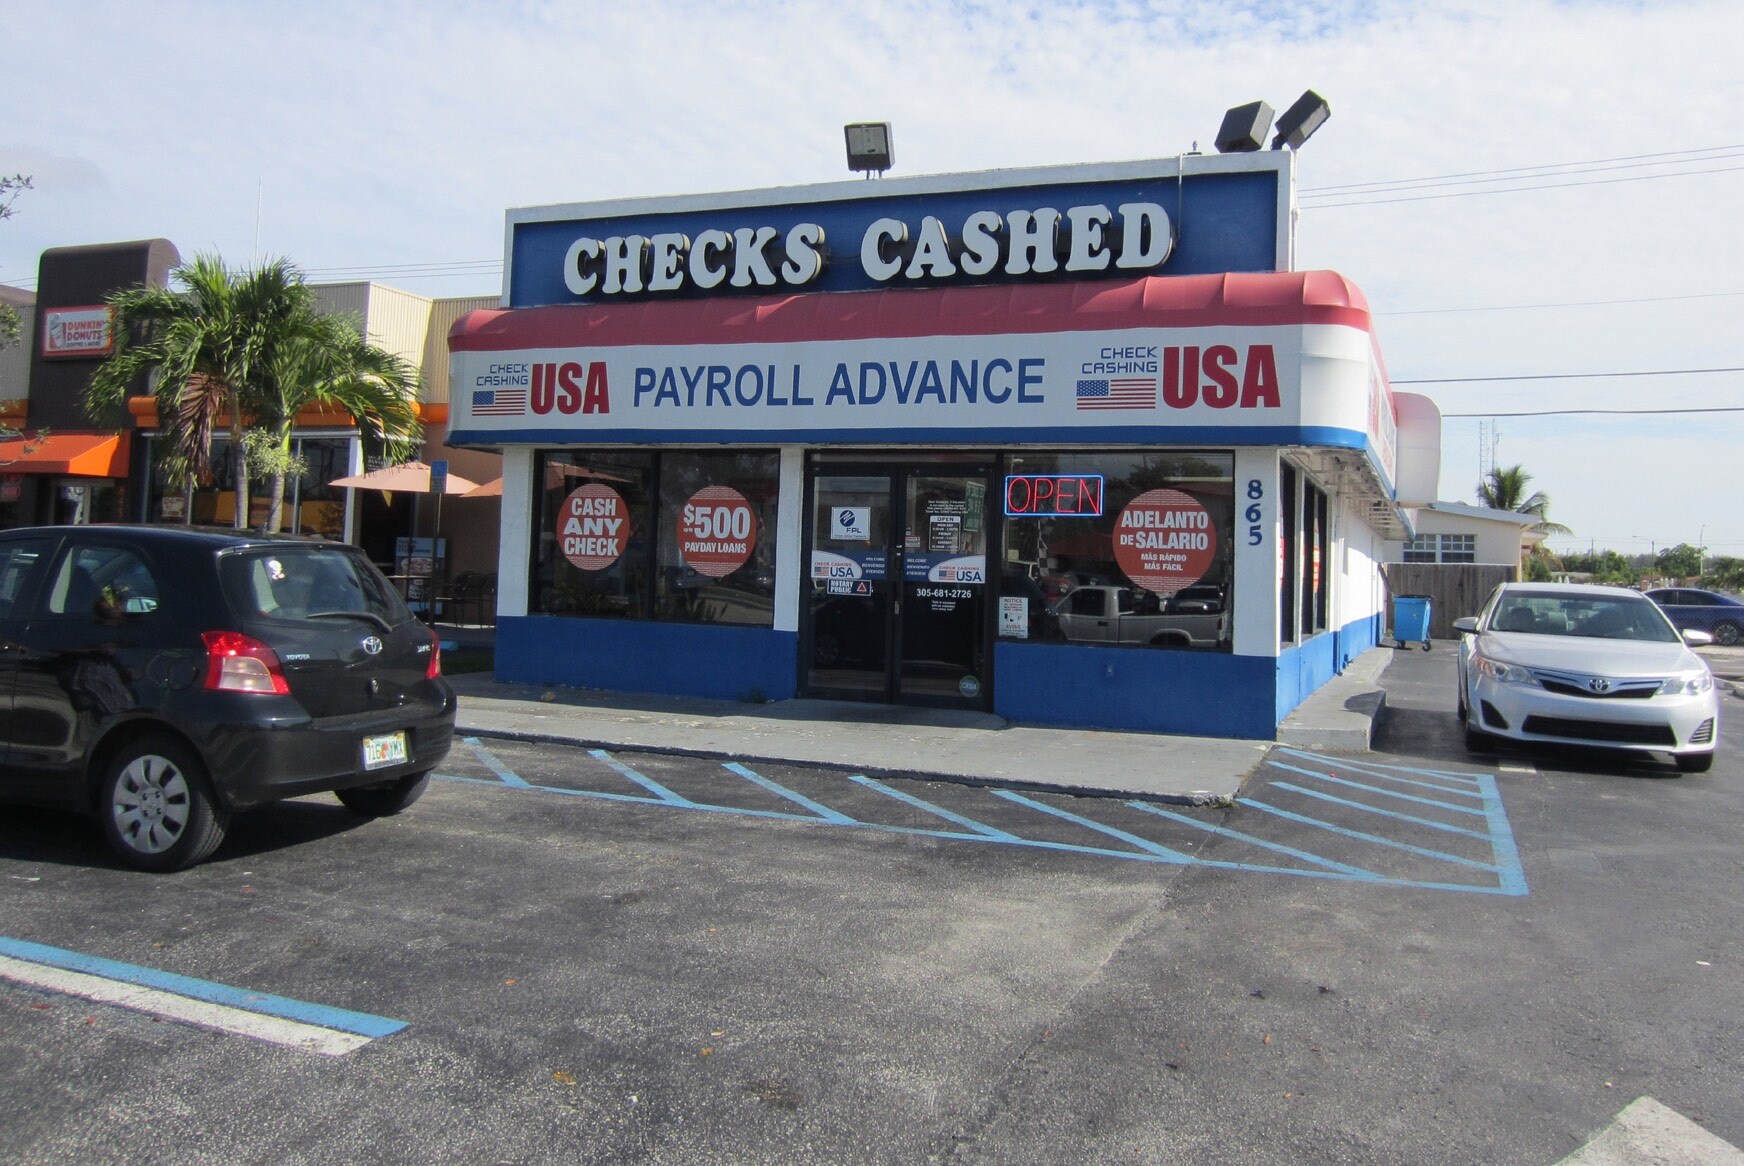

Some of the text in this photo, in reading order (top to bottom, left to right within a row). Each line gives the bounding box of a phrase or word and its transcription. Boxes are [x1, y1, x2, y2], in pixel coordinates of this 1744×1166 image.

[563, 202, 1173, 295] CHECKS CASHED
[67, 331, 102, 341] DONUTS
[1101, 346, 1158, 359] CHECK
[490, 363, 529, 374] CHECK
[1082, 361, 1158, 374] CASHING
[1162, 344, 1281, 409] USA
[476, 375, 529, 386] CASHING
[530, 361, 610, 415] USA
[633, 358, 1045, 407] PAYROLL ADVANCE
[1008, 477, 1101, 515] OPEN
[571, 498, 617, 516] CASH
[1245, 479, 1264, 546] 865
[563, 517, 623, 536] ANY
[683, 503, 750, 539] $500
[1121, 510, 1209, 529] ADELANTO
[564, 537, 619, 556] CHECK
[684, 541, 747, 554] PAYDAY LOANS
[1120, 531, 1209, 550] DE SALARIO
[1141, 551, 1187, 562] MÁS RÁPIDO
[830, 567, 854, 578] USA
[1144, 561, 1183, 571] MÁS FÁCIL
[956, 570, 982, 582] USA
[916, 588, 972, 599] 305-681-2726
